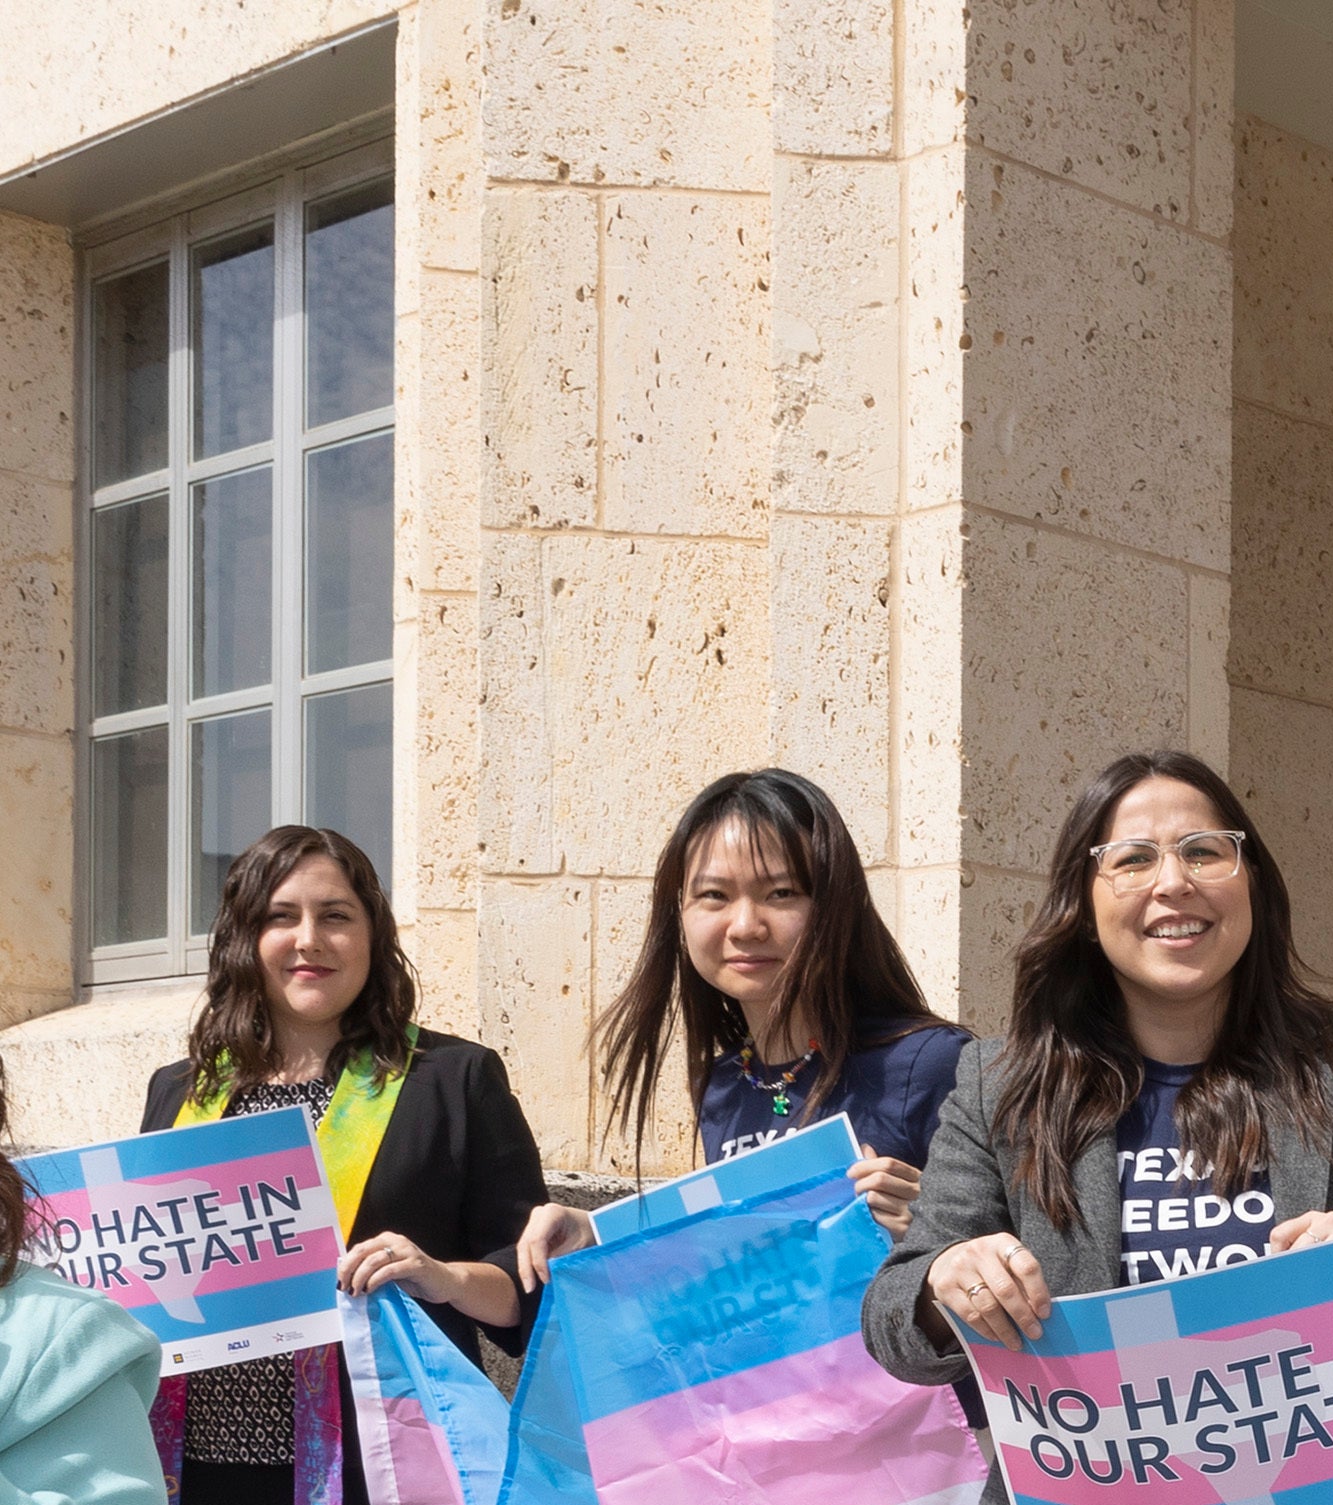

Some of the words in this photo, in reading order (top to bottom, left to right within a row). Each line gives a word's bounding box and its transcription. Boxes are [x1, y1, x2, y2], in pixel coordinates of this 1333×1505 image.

[92, 1191, 228, 1249] HATE
[238, 1175, 302, 1221] IN
[1121, 1190, 1276, 1233] EEDO
[137, 1217, 304, 1282] STATE
[1003, 1377, 1100, 1435] NO
[1118, 1343, 1321, 1432] HATE
[1029, 1433, 1182, 1485] OUR
